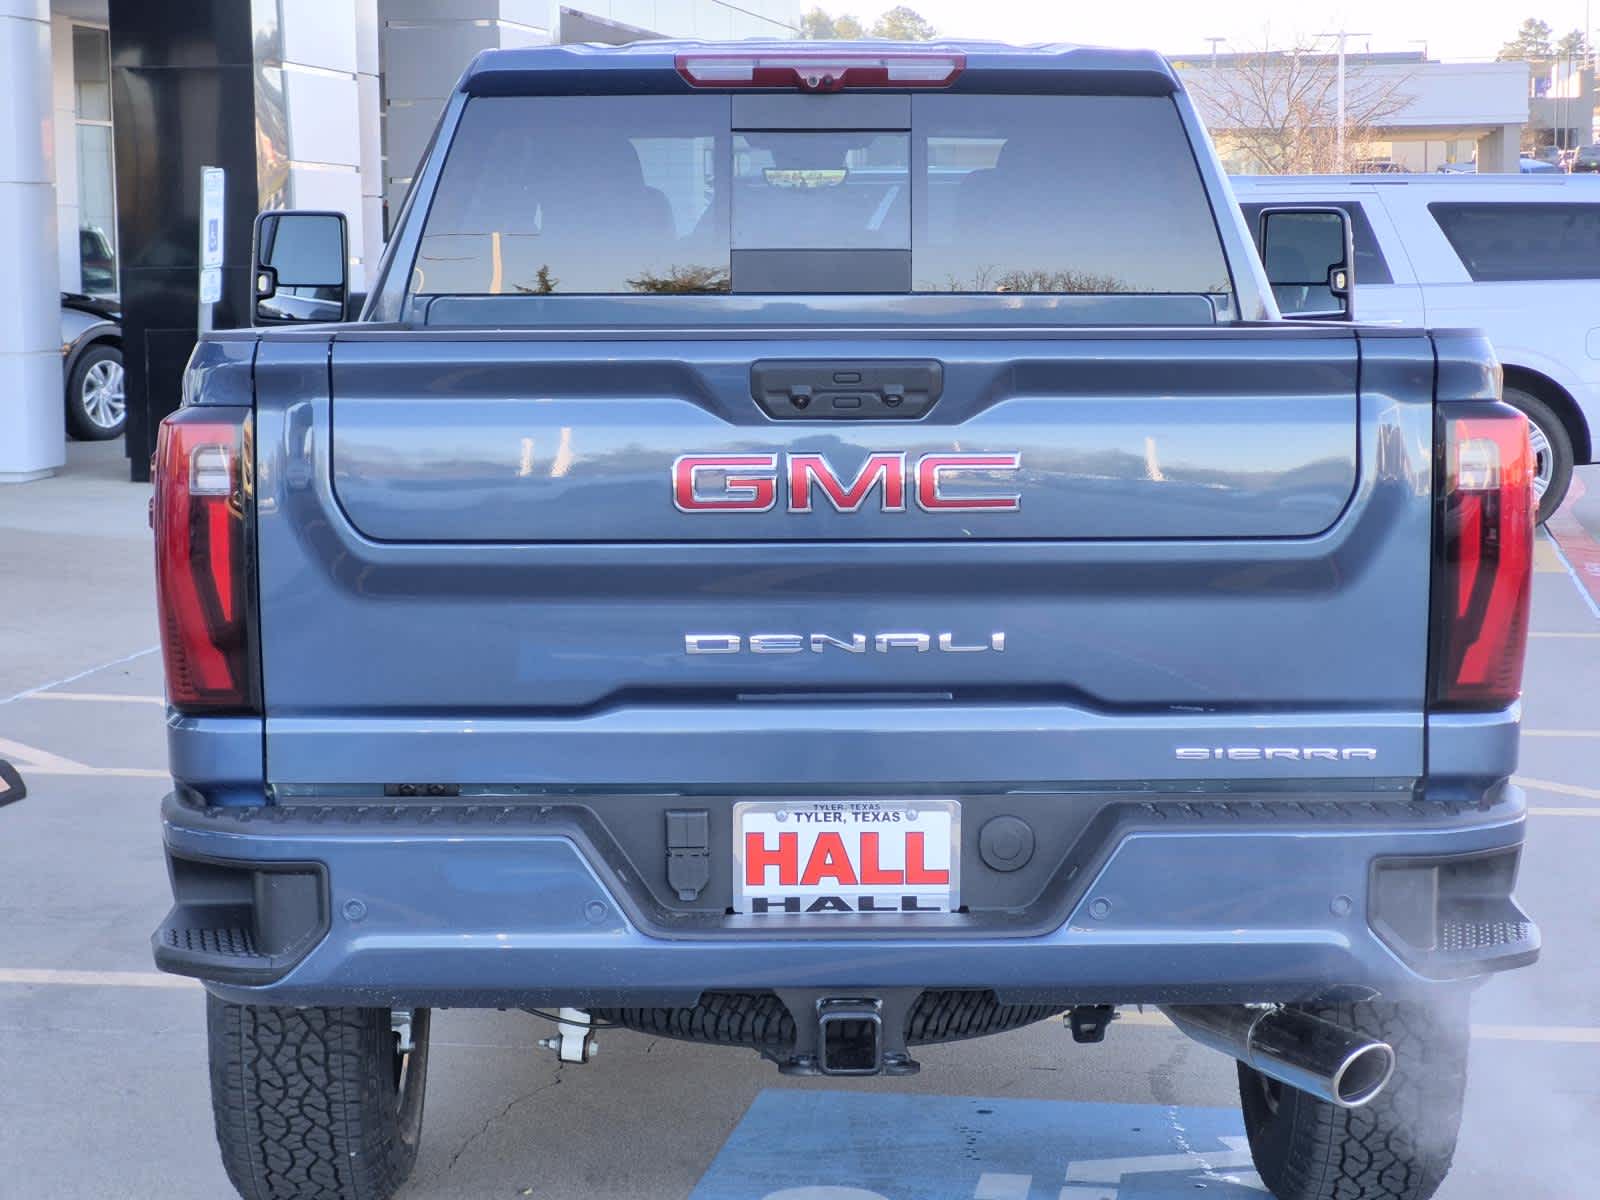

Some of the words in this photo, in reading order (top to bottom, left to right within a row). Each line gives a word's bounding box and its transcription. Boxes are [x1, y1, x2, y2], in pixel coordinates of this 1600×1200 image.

[671, 452, 1022, 513] GMC
[685, 632, 1005, 654] DENALI
[1175, 747, 1377, 760] SIERRA
[849, 803, 881, 811] TEXAS
[794, 812, 847, 824] TYLER,
[852, 812, 901, 823] TEXAS
[745, 831, 949, 886] HALL
[752, 896, 941, 913] HALL
